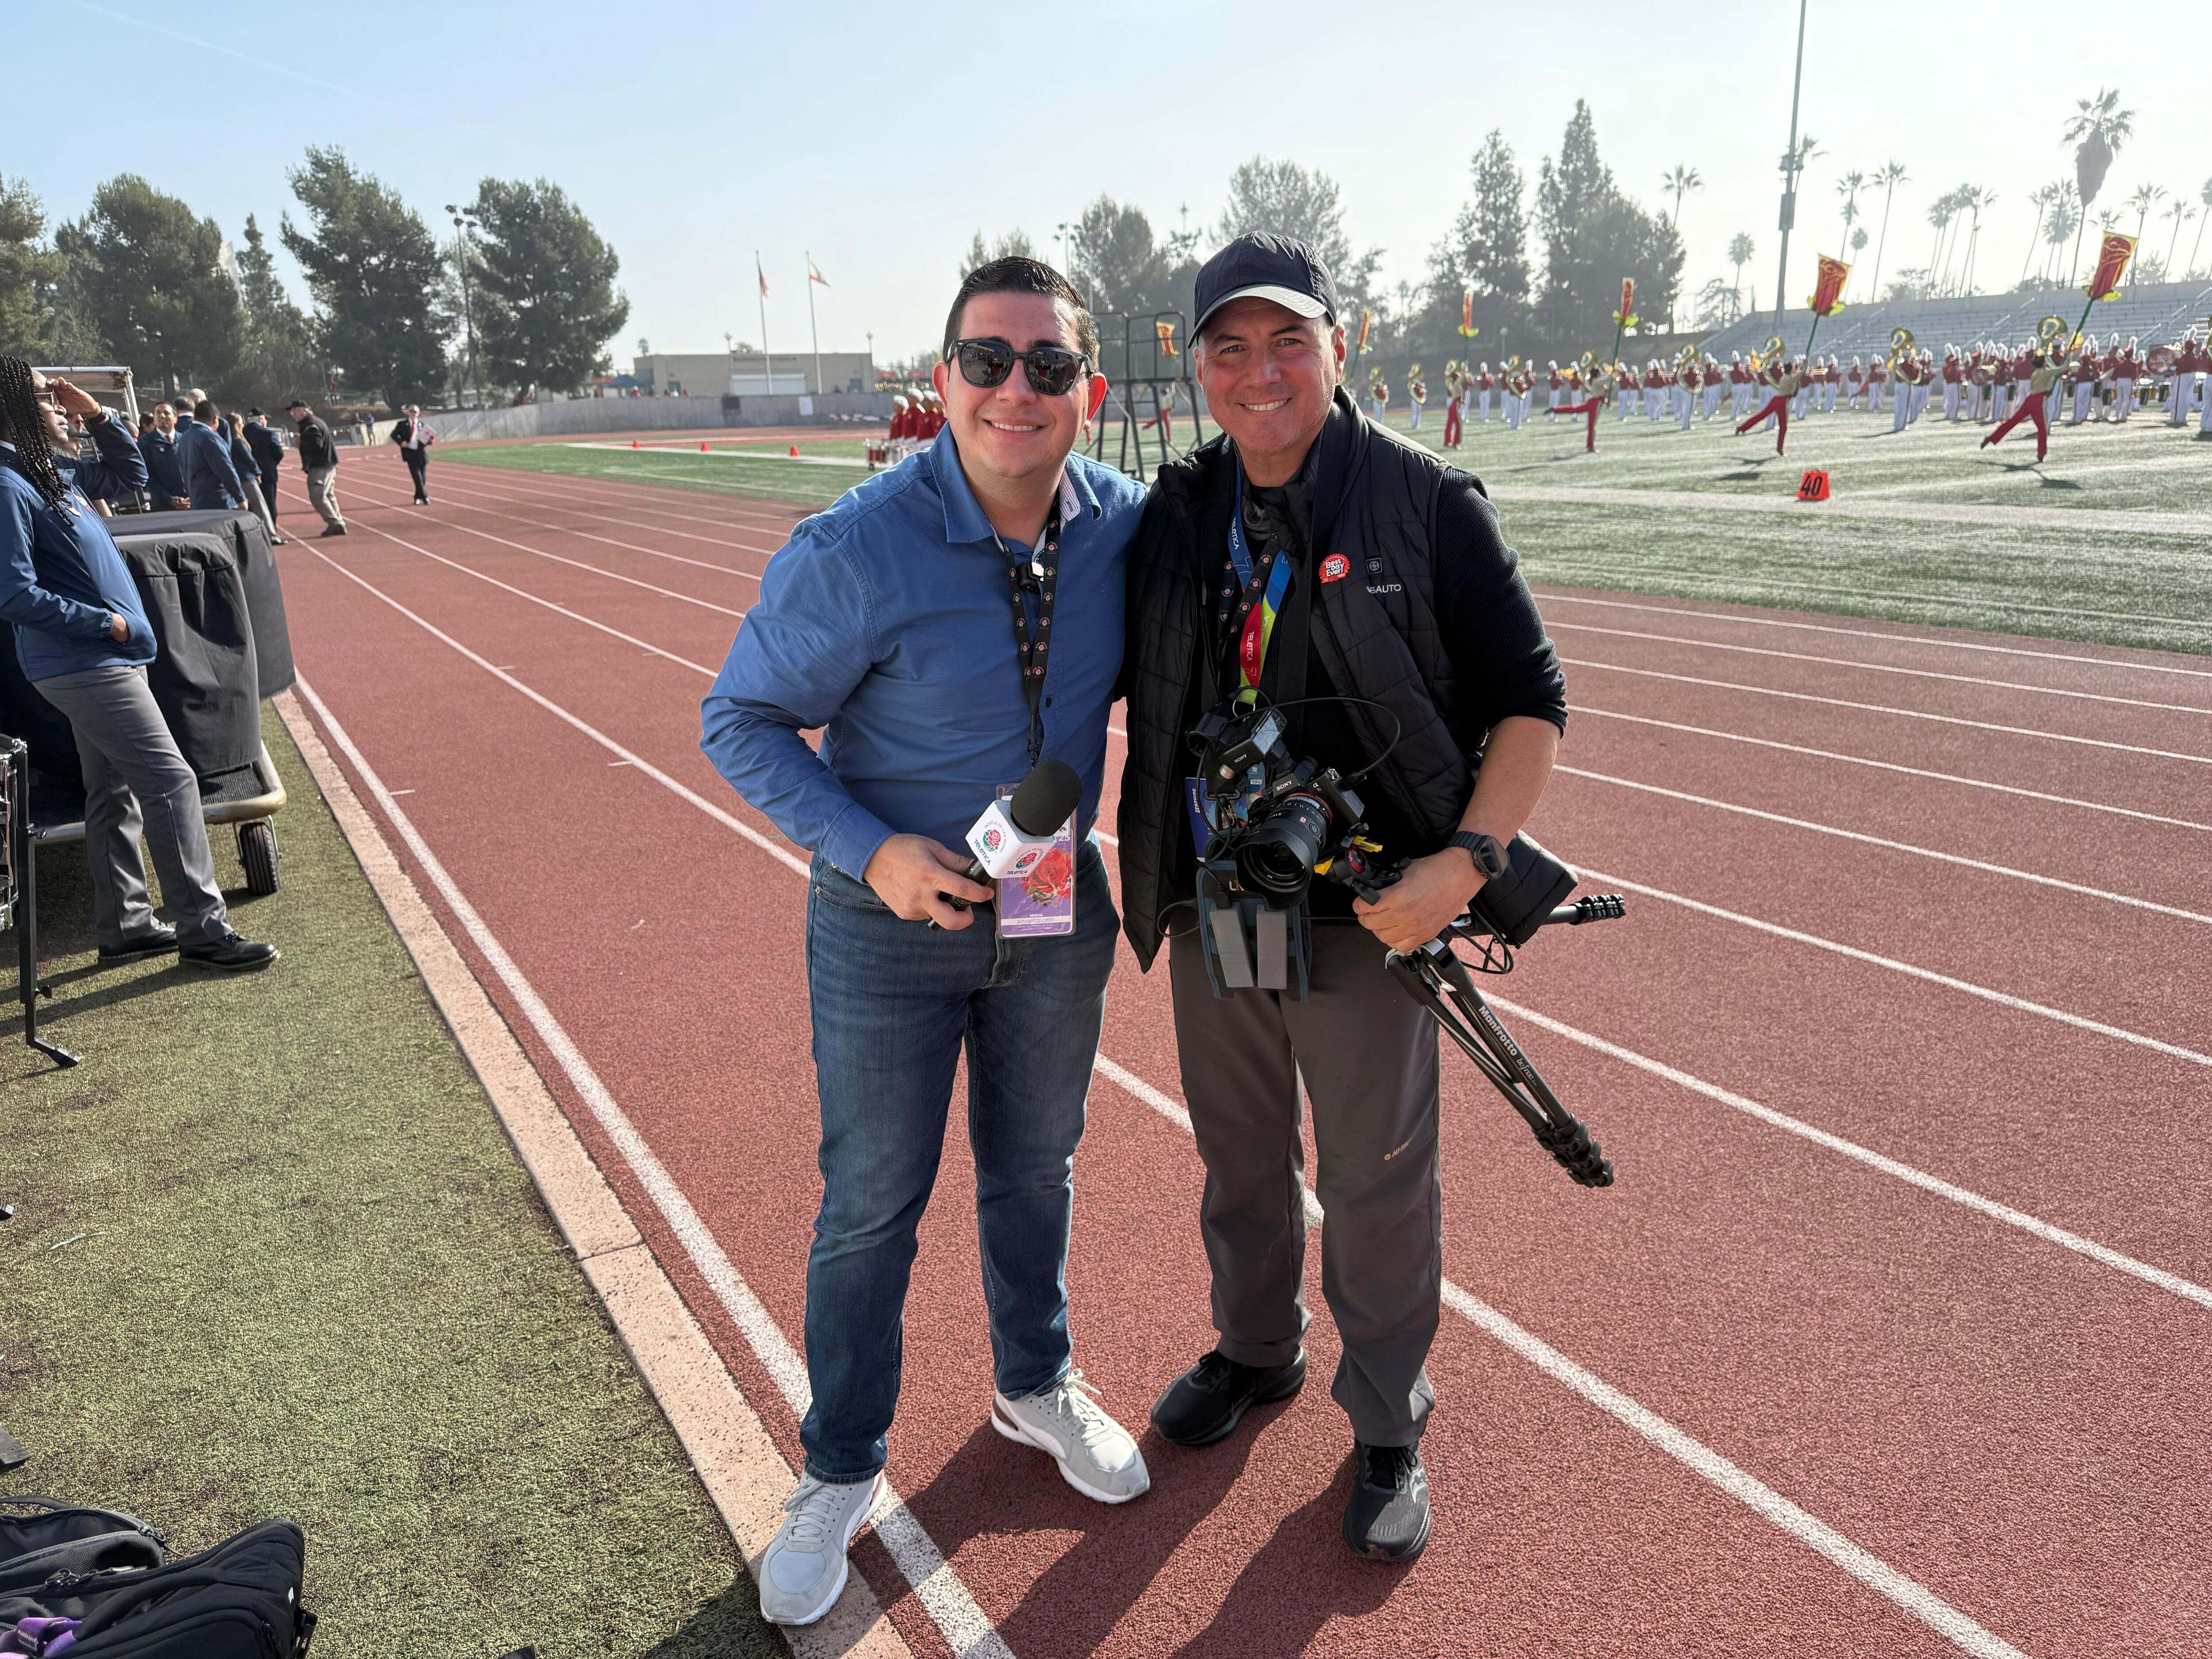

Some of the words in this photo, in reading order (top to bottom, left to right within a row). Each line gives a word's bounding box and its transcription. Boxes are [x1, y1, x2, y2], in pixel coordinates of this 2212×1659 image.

[1801, 474, 1822, 496] 40
[1276, 780, 1292, 791] SONY
[1479, 1005, 1517, 1056] Manfrotto
